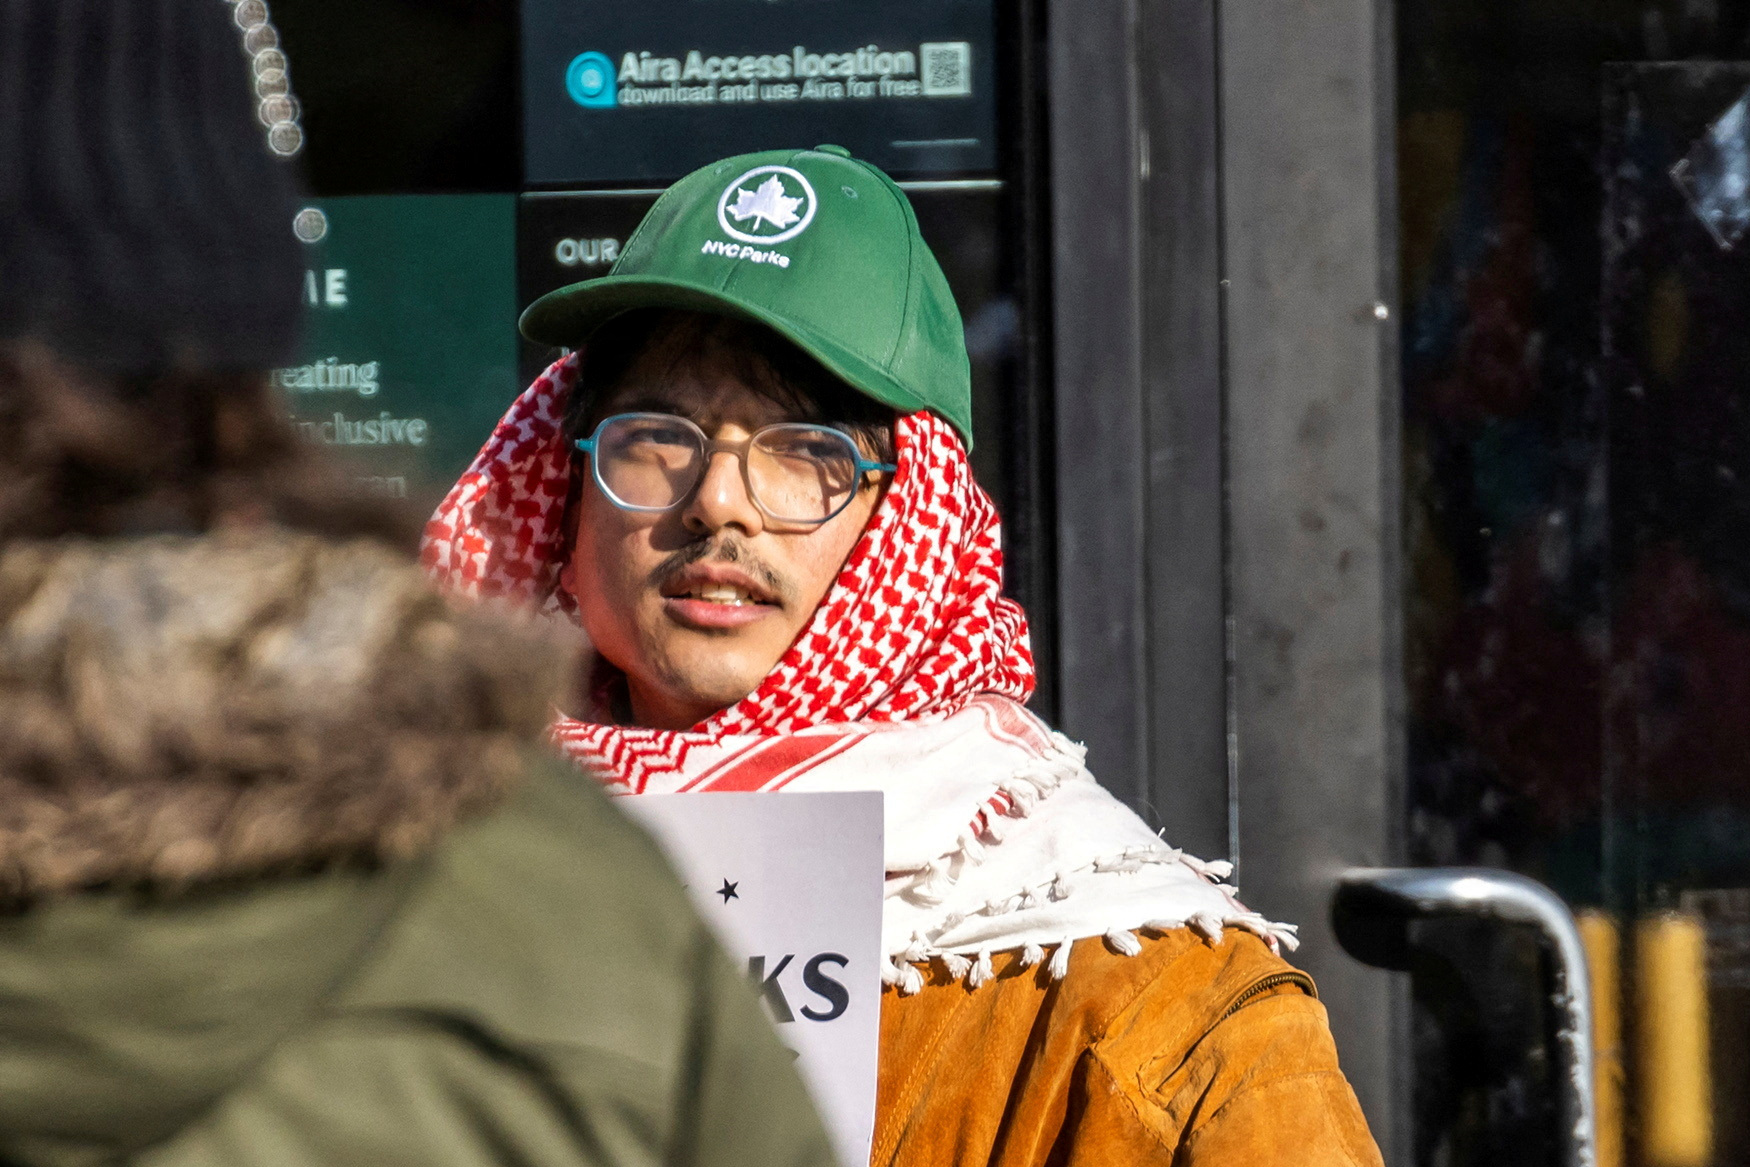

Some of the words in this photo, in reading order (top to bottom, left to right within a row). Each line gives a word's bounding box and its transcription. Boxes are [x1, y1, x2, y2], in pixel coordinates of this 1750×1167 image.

[618, 52, 681, 82] Aira
[682, 50, 793, 79] Access
[794, 45, 916, 77] location
[618, 82, 714, 105] download
[718, 79, 760, 101] and
[761, 82, 799, 99] use
[800, 78, 845, 98] Aira
[846, 77, 876, 97] for
[879, 77, 921, 97] free
[555, 238, 619, 264] OUR
[701, 239, 740, 258] NYC
[739, 245, 790, 268] Parks
